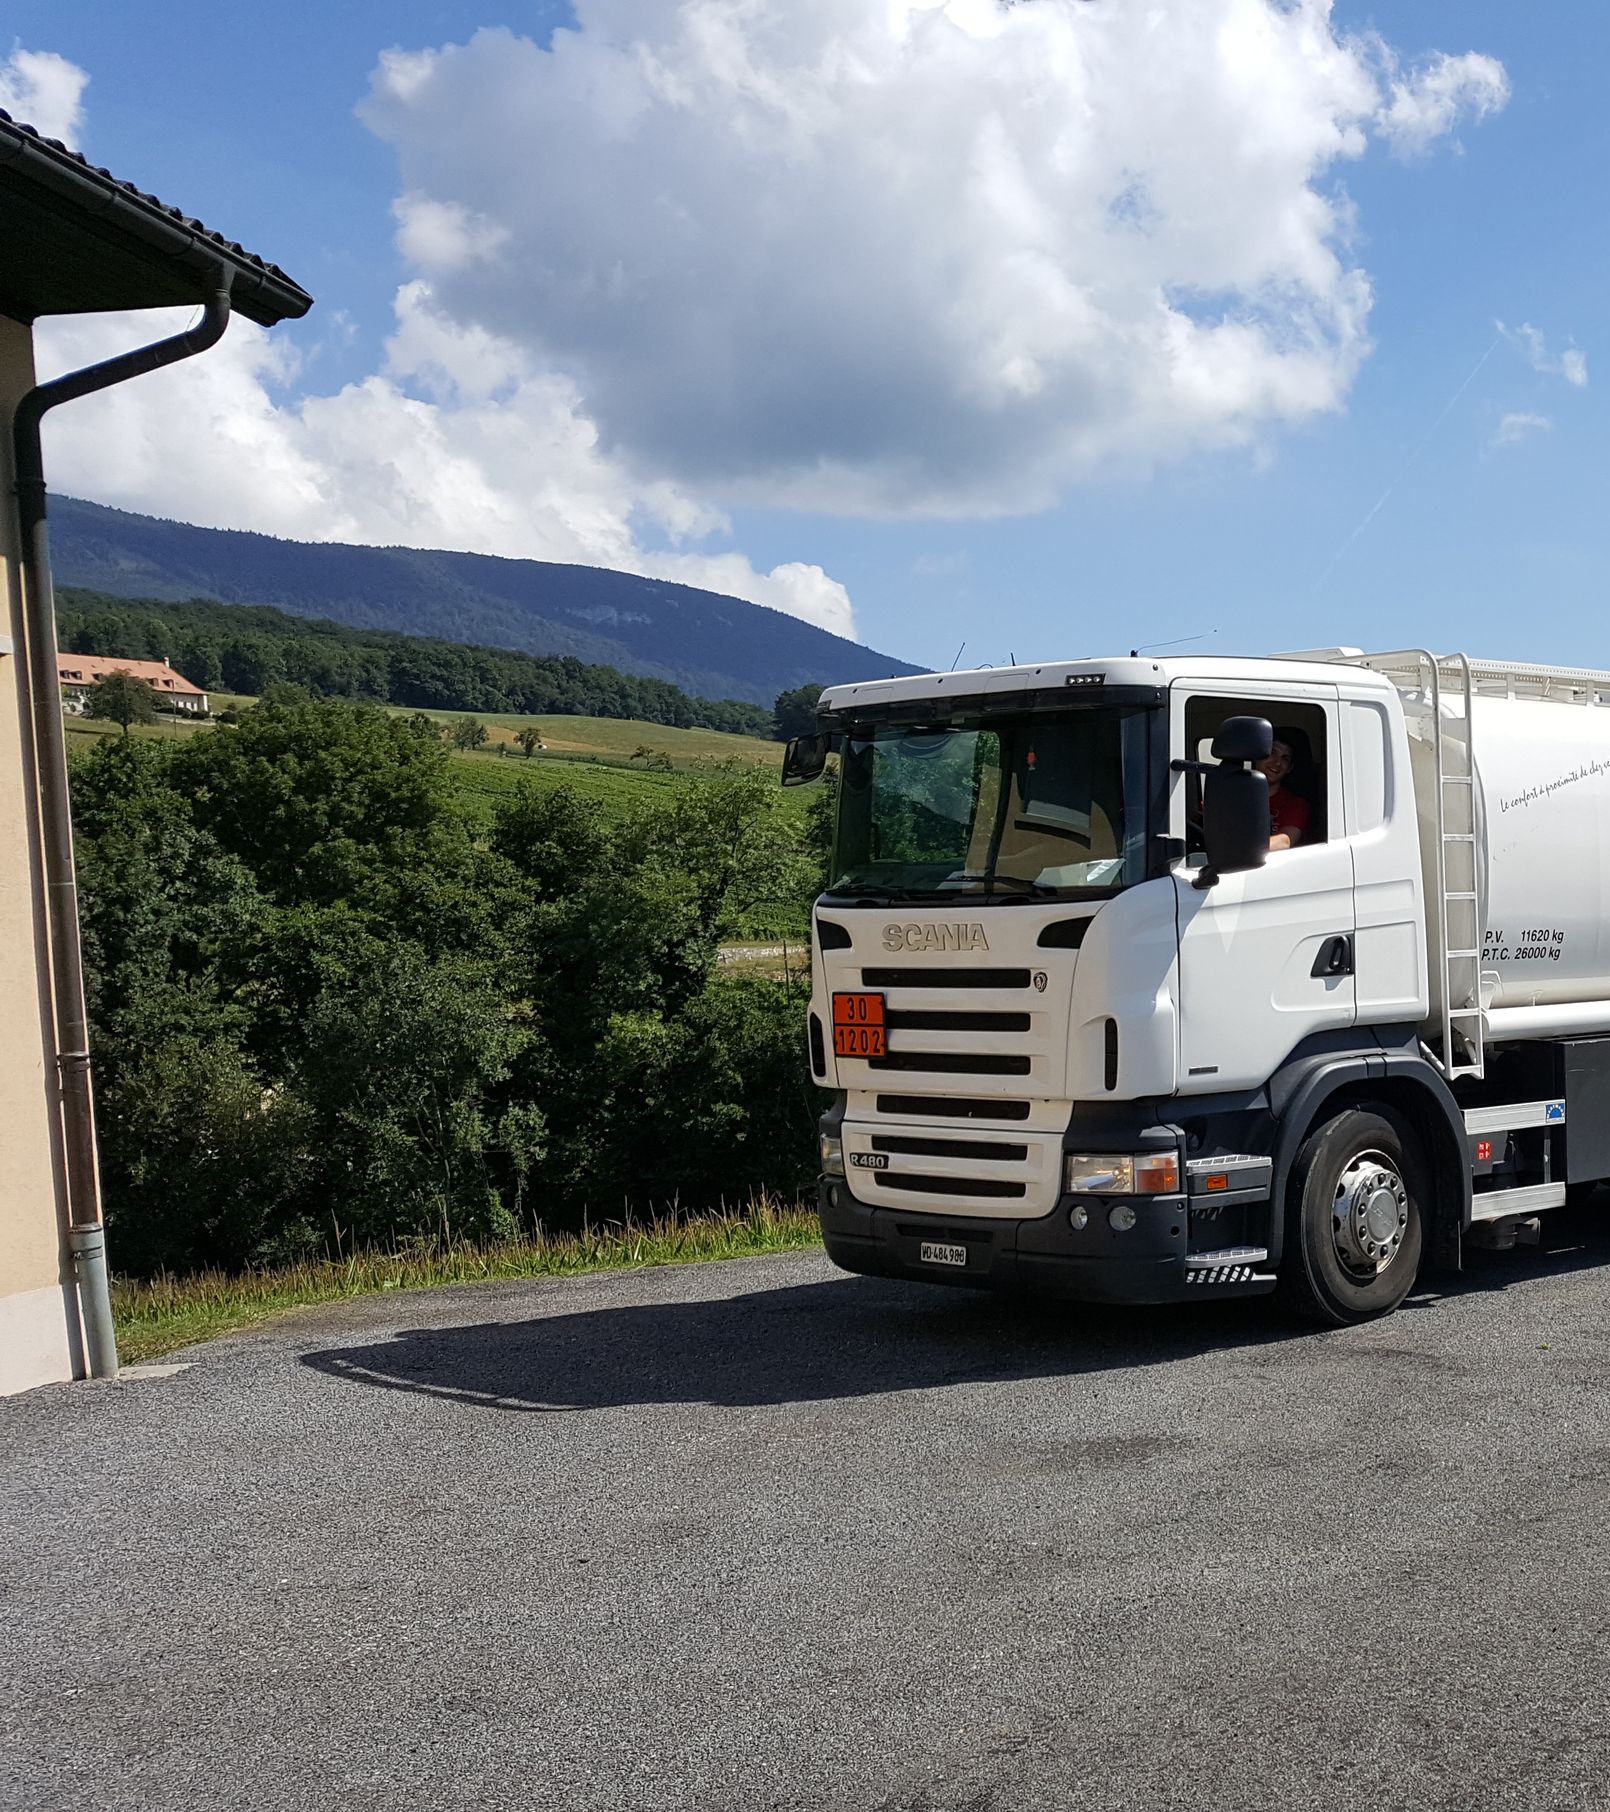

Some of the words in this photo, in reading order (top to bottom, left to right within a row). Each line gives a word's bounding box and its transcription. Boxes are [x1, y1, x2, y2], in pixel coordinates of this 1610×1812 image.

[1500, 799, 1510, 813] Le
[1511, 787, 1538, 807] confort
[1545, 771, 1579, 797] proximité
[1580, 765, 1588, 778] de
[1589, 760, 1604, 776] chez
[882, 923, 990, 952] SCANIA
[1484, 930, 1504, 943] P.V.
[1521, 929, 1550, 942] 11620
[1551, 929, 1564, 944] kg
[1481, 947, 1510, 961] P.T.C.
[1514, 946, 1547, 960] 26000
[1548, 946, 1561, 961] kg
[847, 997, 868, 1021] 30
[839, 1029, 881, 1054] 1202
